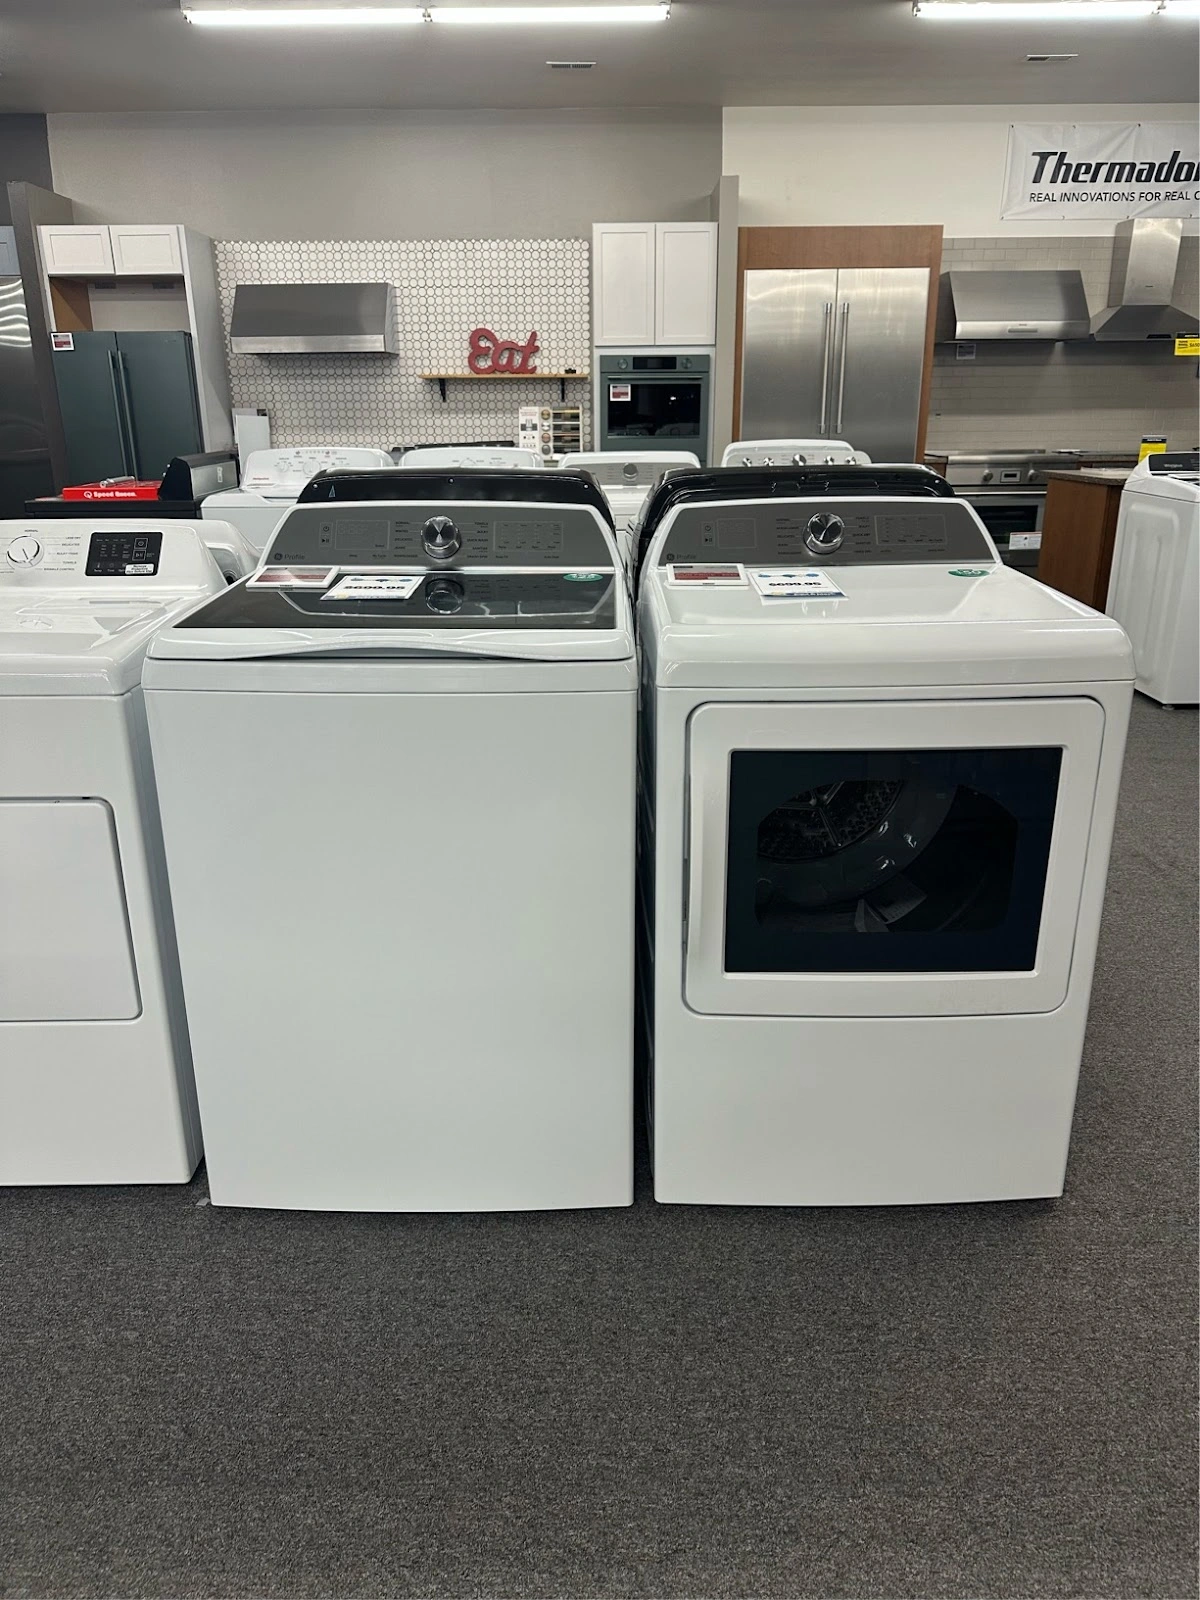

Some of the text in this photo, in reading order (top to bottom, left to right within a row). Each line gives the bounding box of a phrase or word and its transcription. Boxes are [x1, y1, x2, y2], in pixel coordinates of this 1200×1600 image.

[1031, 150, 1199, 184] Thermado
[1029, 192, 1057, 203] REAL
[1060, 191, 1136, 203] INNOVATIONS
[1138, 191, 1162, 201] FOR
[1164, 191, 1191, 201] REAL
[468, 327, 540, 374] Eat
